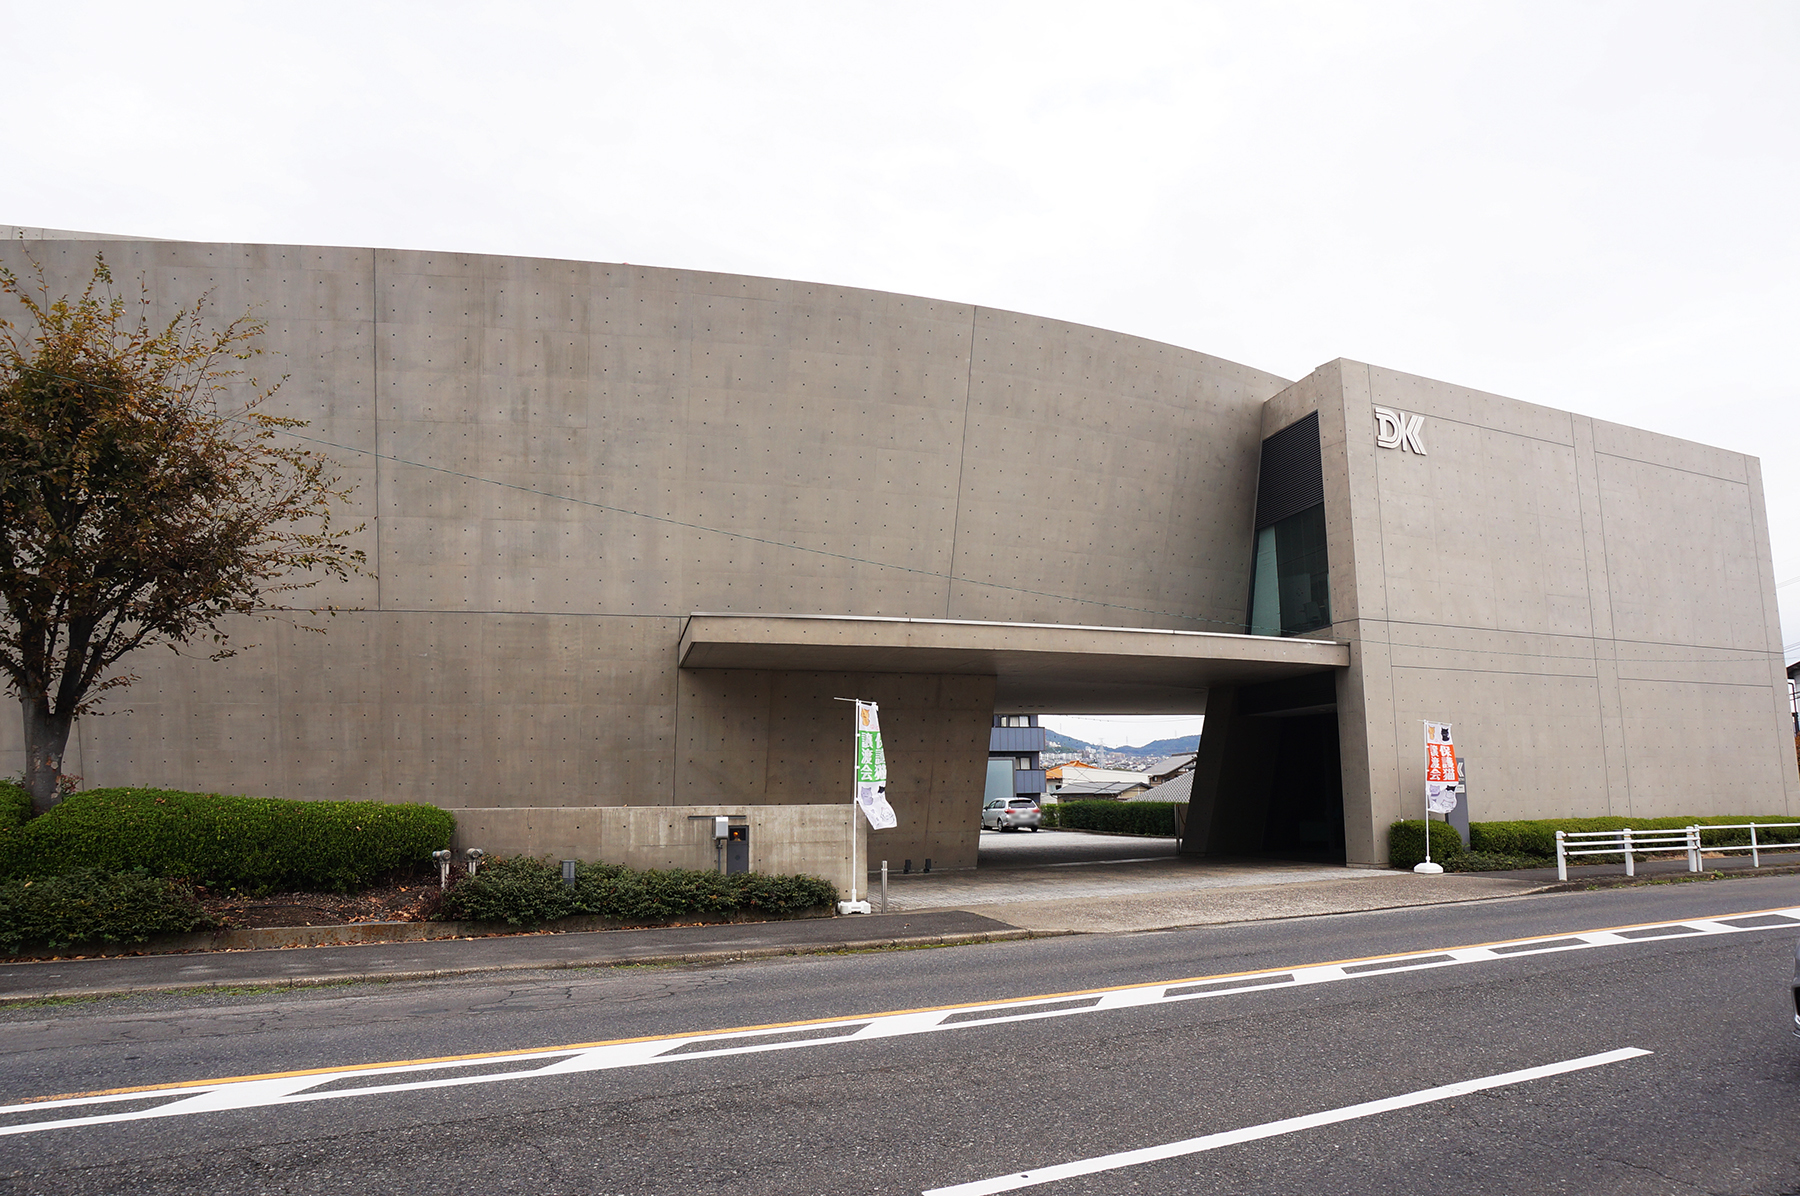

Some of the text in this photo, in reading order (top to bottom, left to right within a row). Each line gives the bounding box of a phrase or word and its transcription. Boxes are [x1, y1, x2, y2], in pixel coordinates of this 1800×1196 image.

[1374, 407, 1428, 456] DK
[1440, 745, 1456, 780] 保護猫
